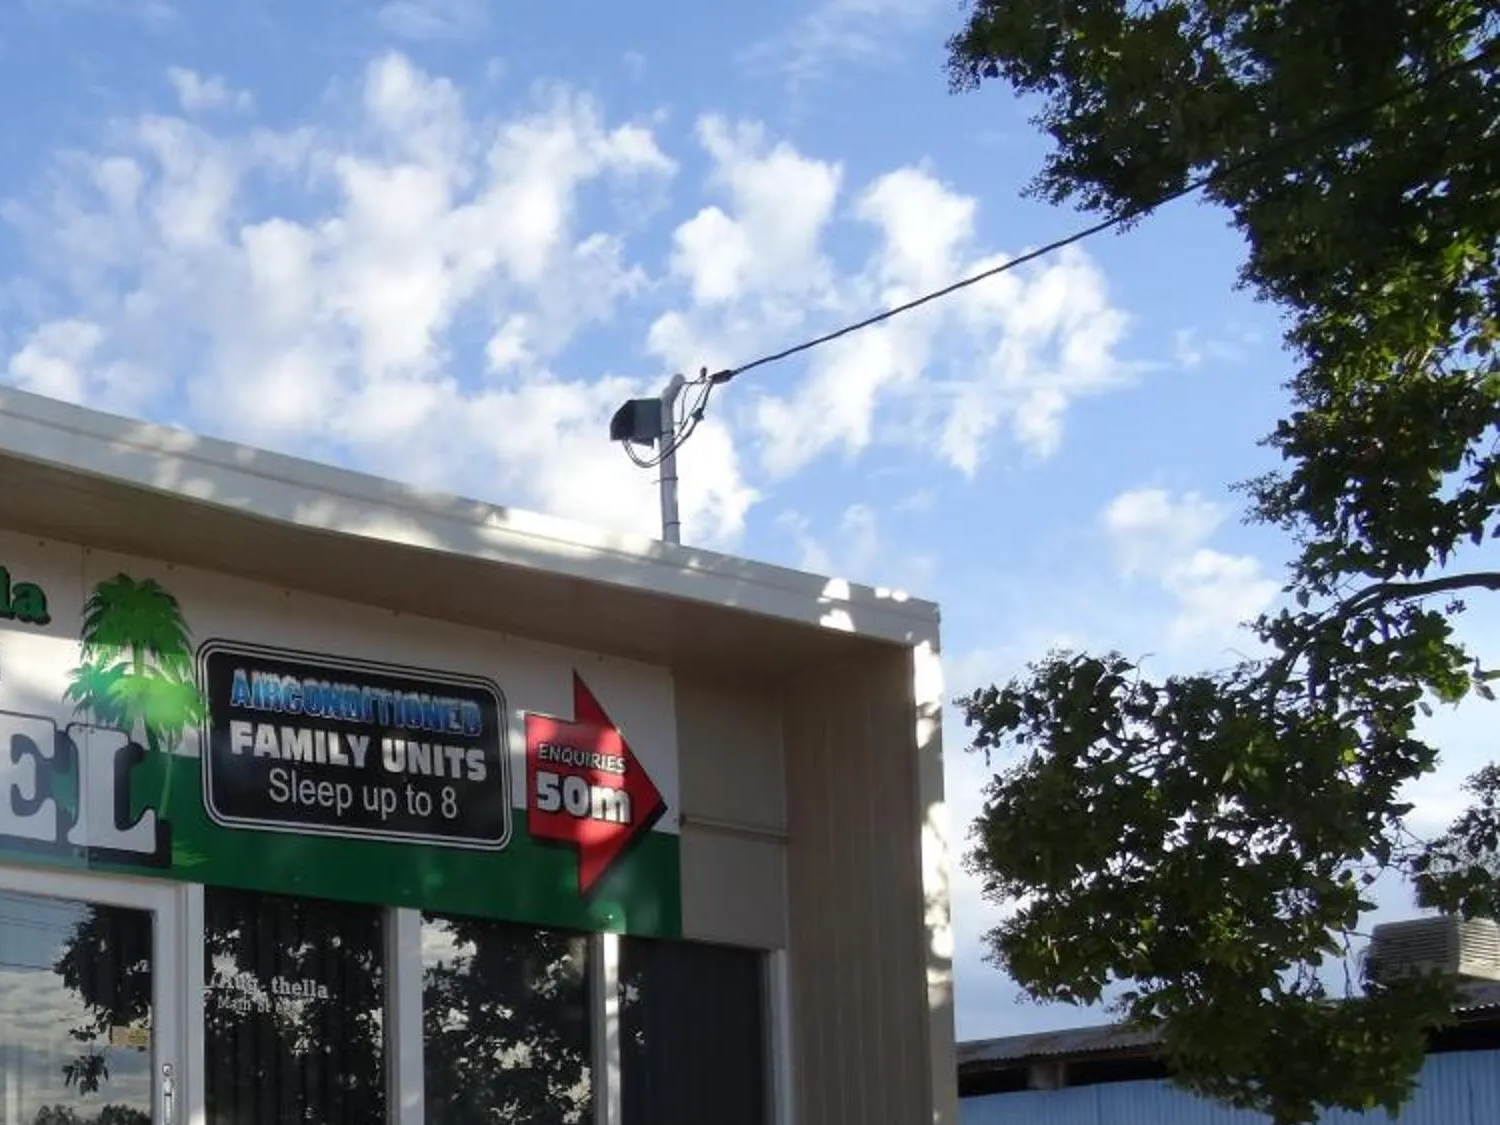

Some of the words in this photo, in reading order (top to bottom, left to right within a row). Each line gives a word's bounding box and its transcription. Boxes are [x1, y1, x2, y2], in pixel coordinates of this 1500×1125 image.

[230, 668, 482, 736] AIRCONDITIONED
[230, 720, 370, 768] FAMILY
[381, 738, 487, 782] UNITS
[539, 743, 625, 773] ENQUIRIES
[268, 767, 353, 817] Sleep
[362, 785, 397, 820] up
[405, 784, 433, 816] to
[441, 786, 458, 818] 8
[536, 771, 630, 822] 50m
[219, 973, 329, 998] Augthella
